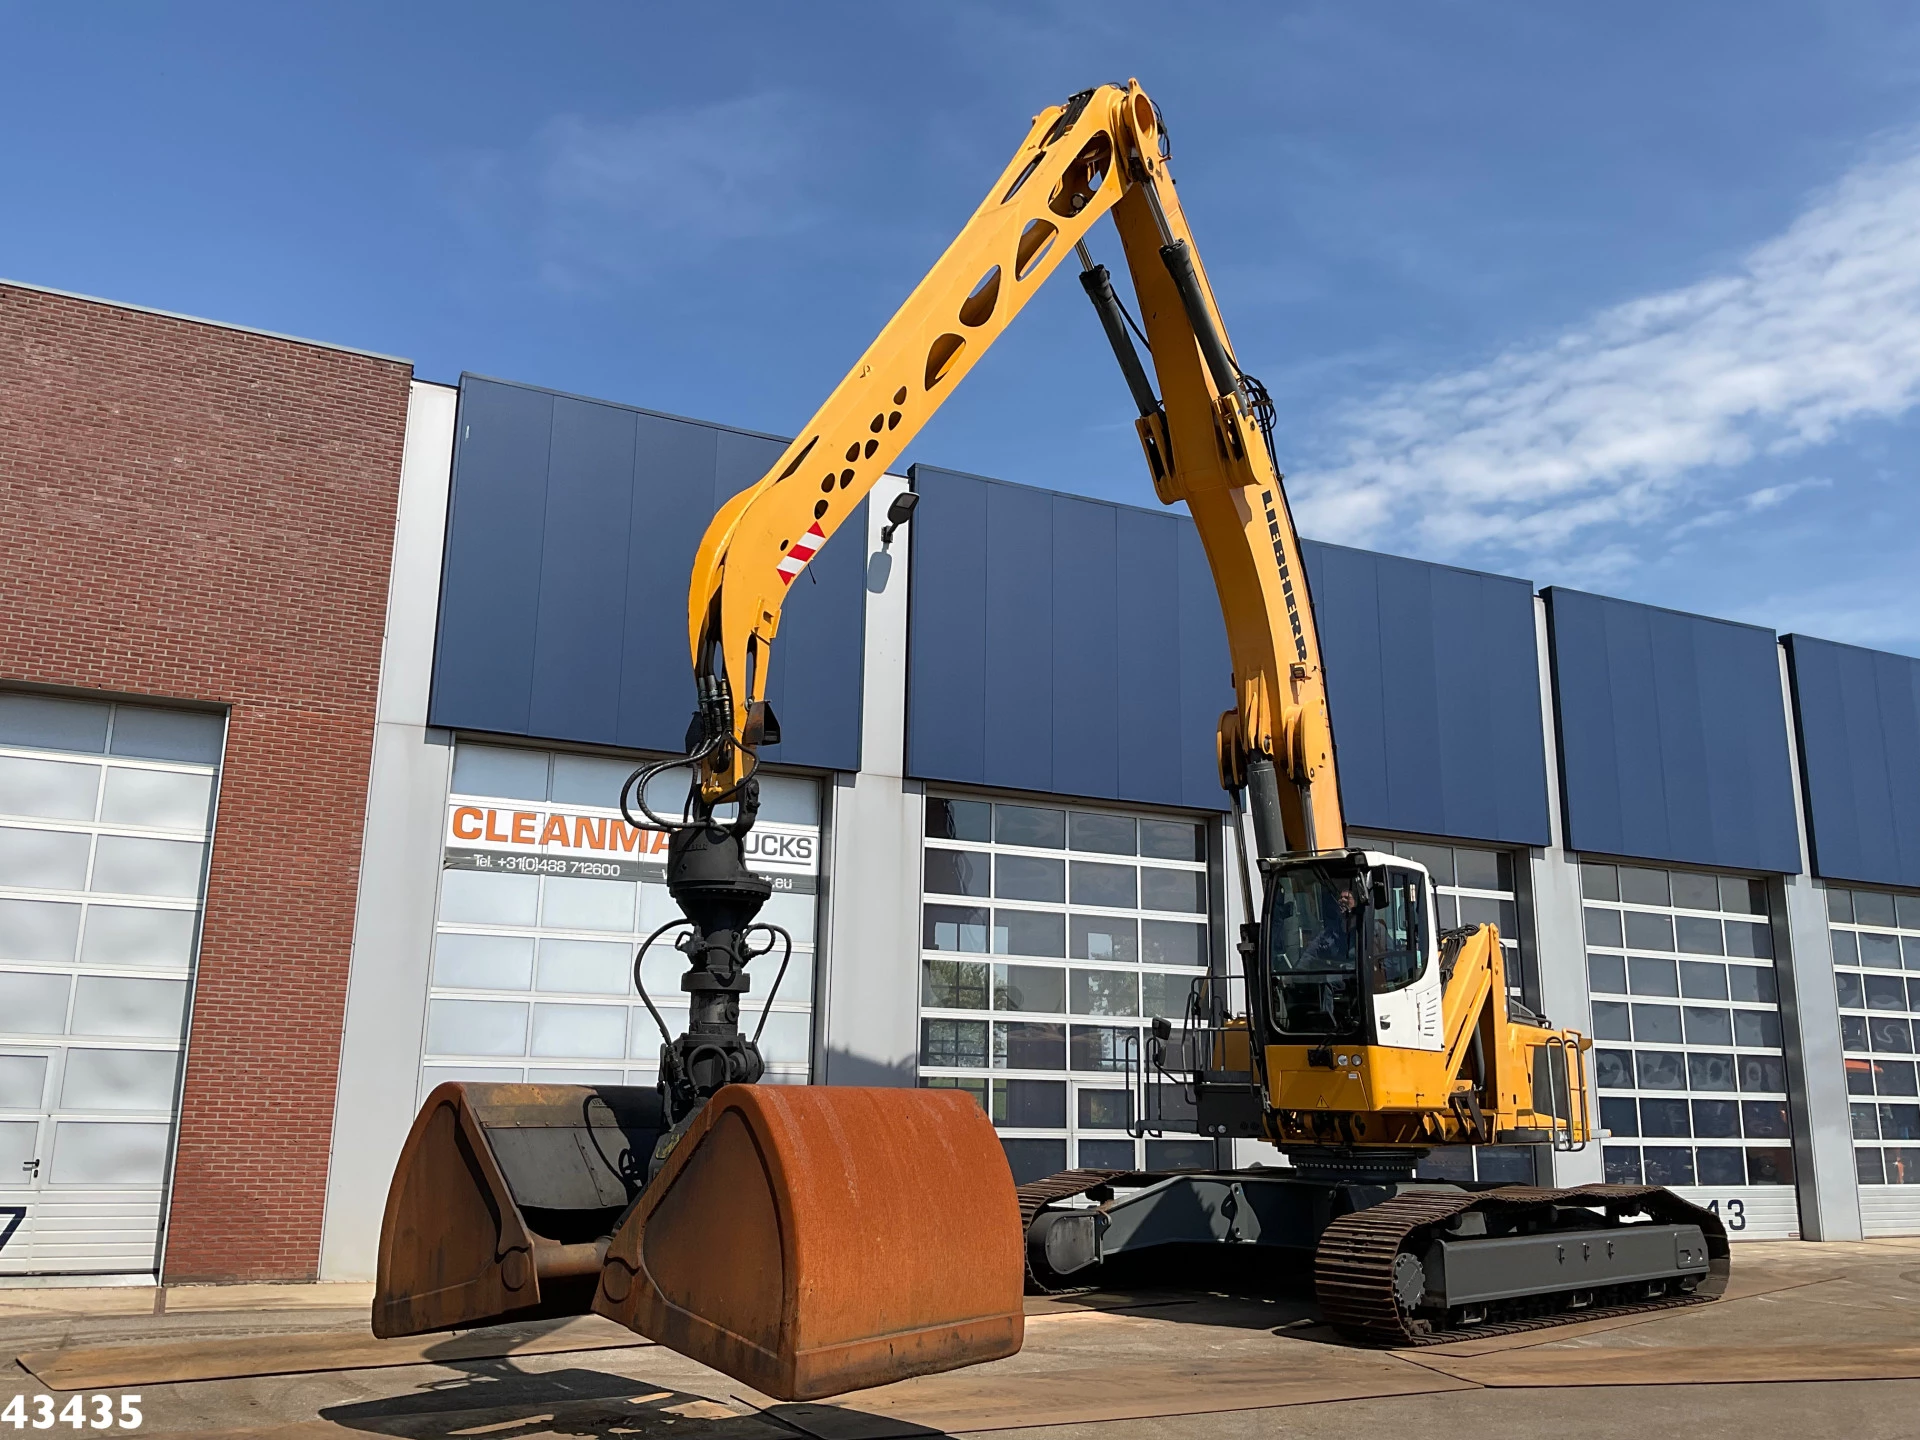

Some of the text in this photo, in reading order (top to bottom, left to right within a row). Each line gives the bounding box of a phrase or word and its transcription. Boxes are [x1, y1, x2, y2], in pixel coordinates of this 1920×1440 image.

[1261, 489, 1308, 663] LIEBHERR
[452, 806, 812, 859] CLEANMA UCKS
[473, 854, 493, 868] Tel.
[569, 861, 621, 877] 712600
